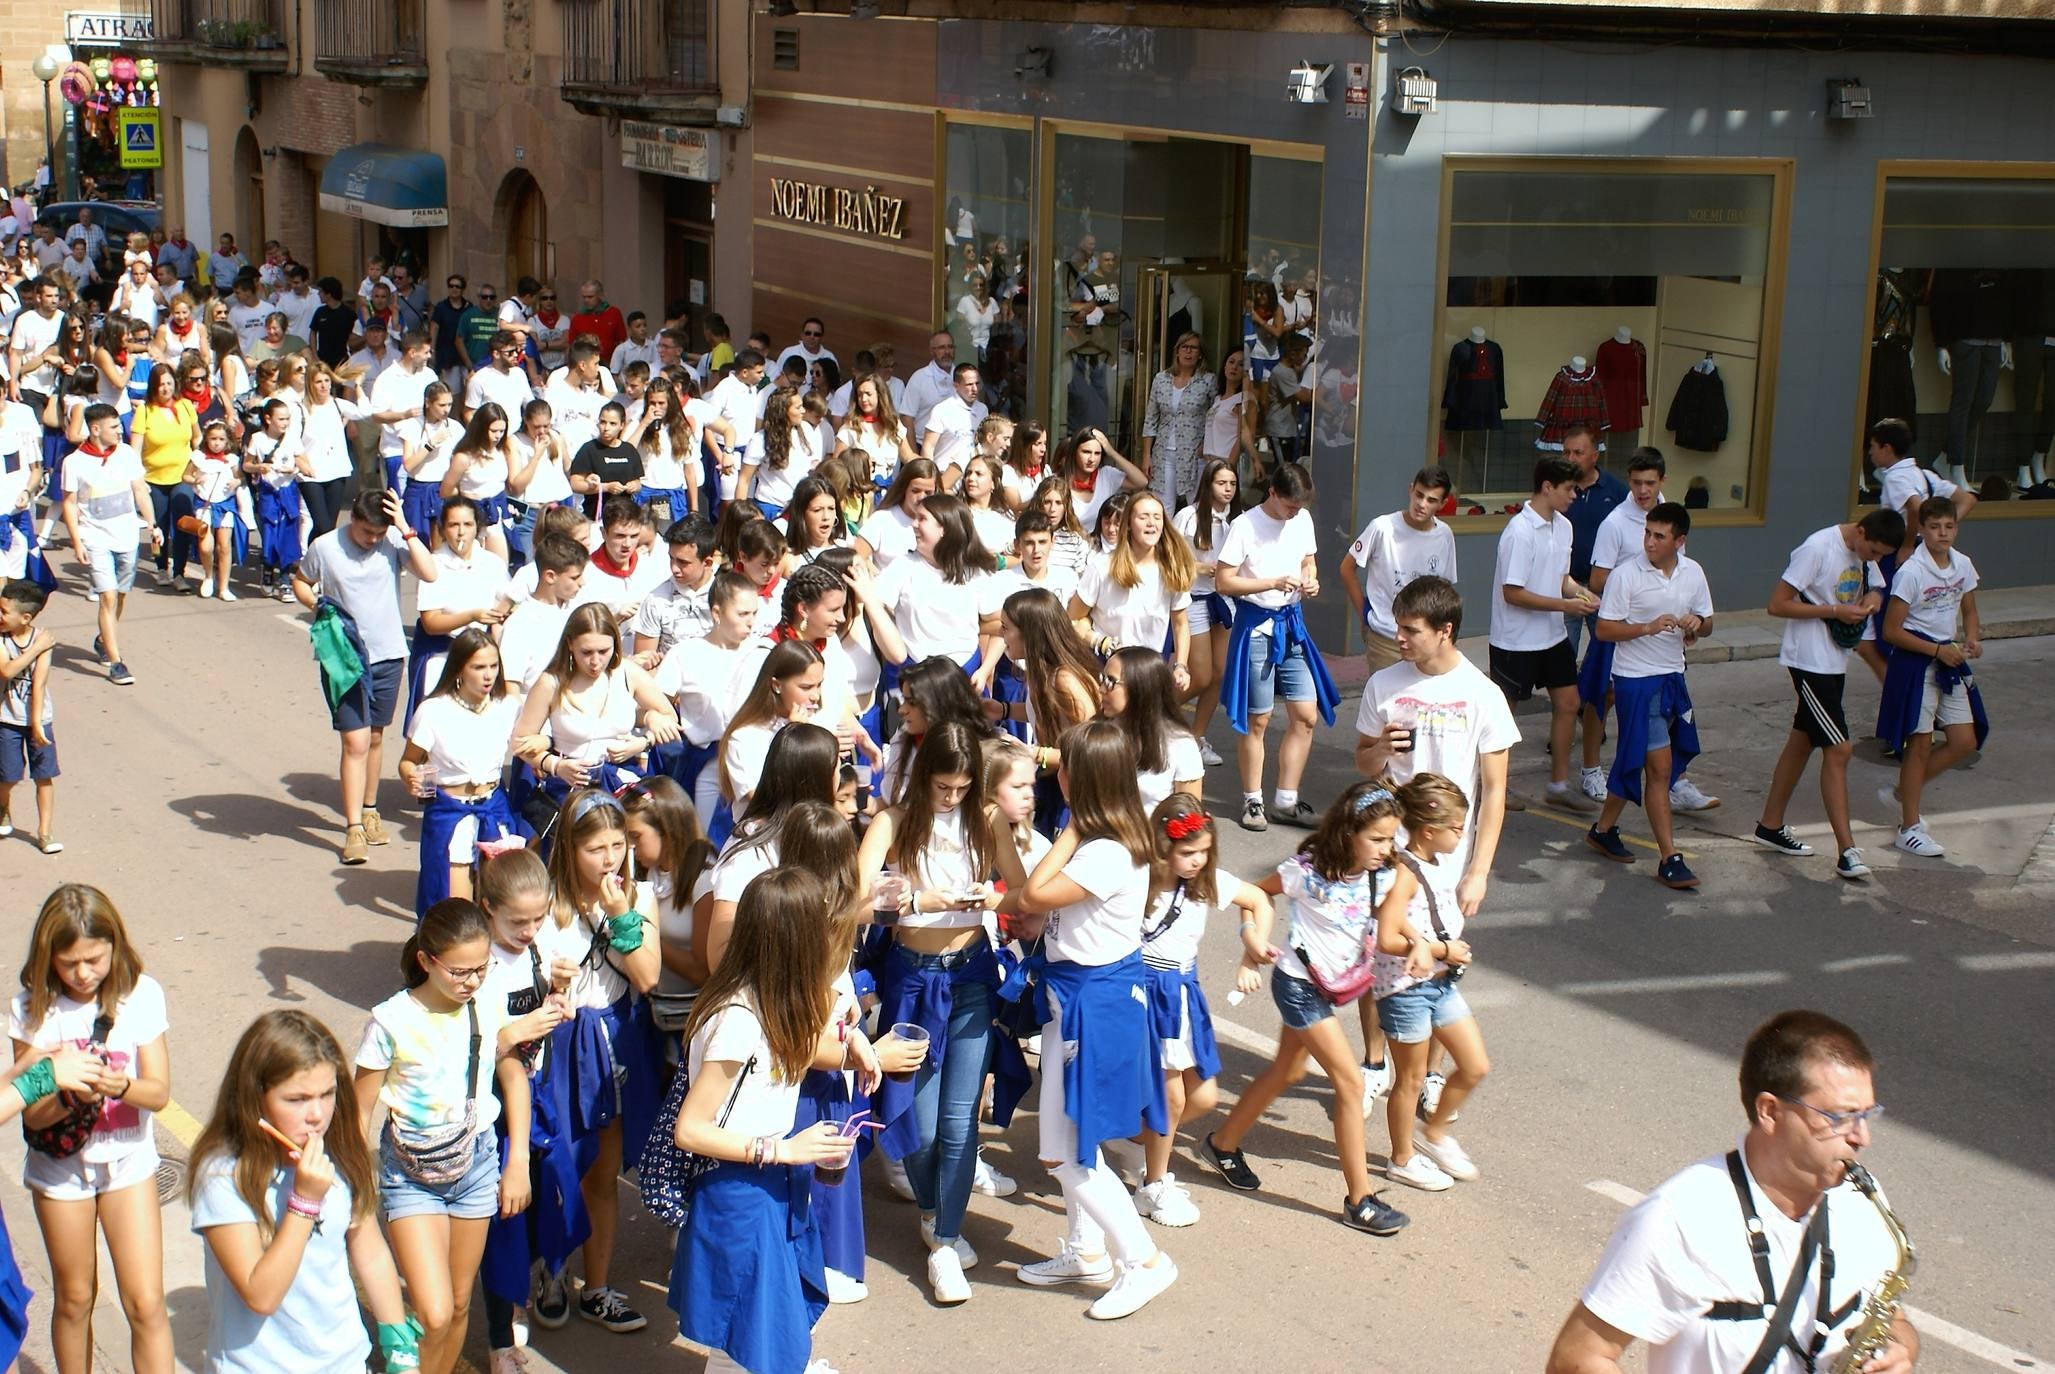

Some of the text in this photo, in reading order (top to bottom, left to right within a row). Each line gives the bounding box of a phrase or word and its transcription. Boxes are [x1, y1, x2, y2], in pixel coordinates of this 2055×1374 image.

[411, 209, 443, 217] PRENSA
[770, 178, 902, 239] NOEMI IBAÑEZ
